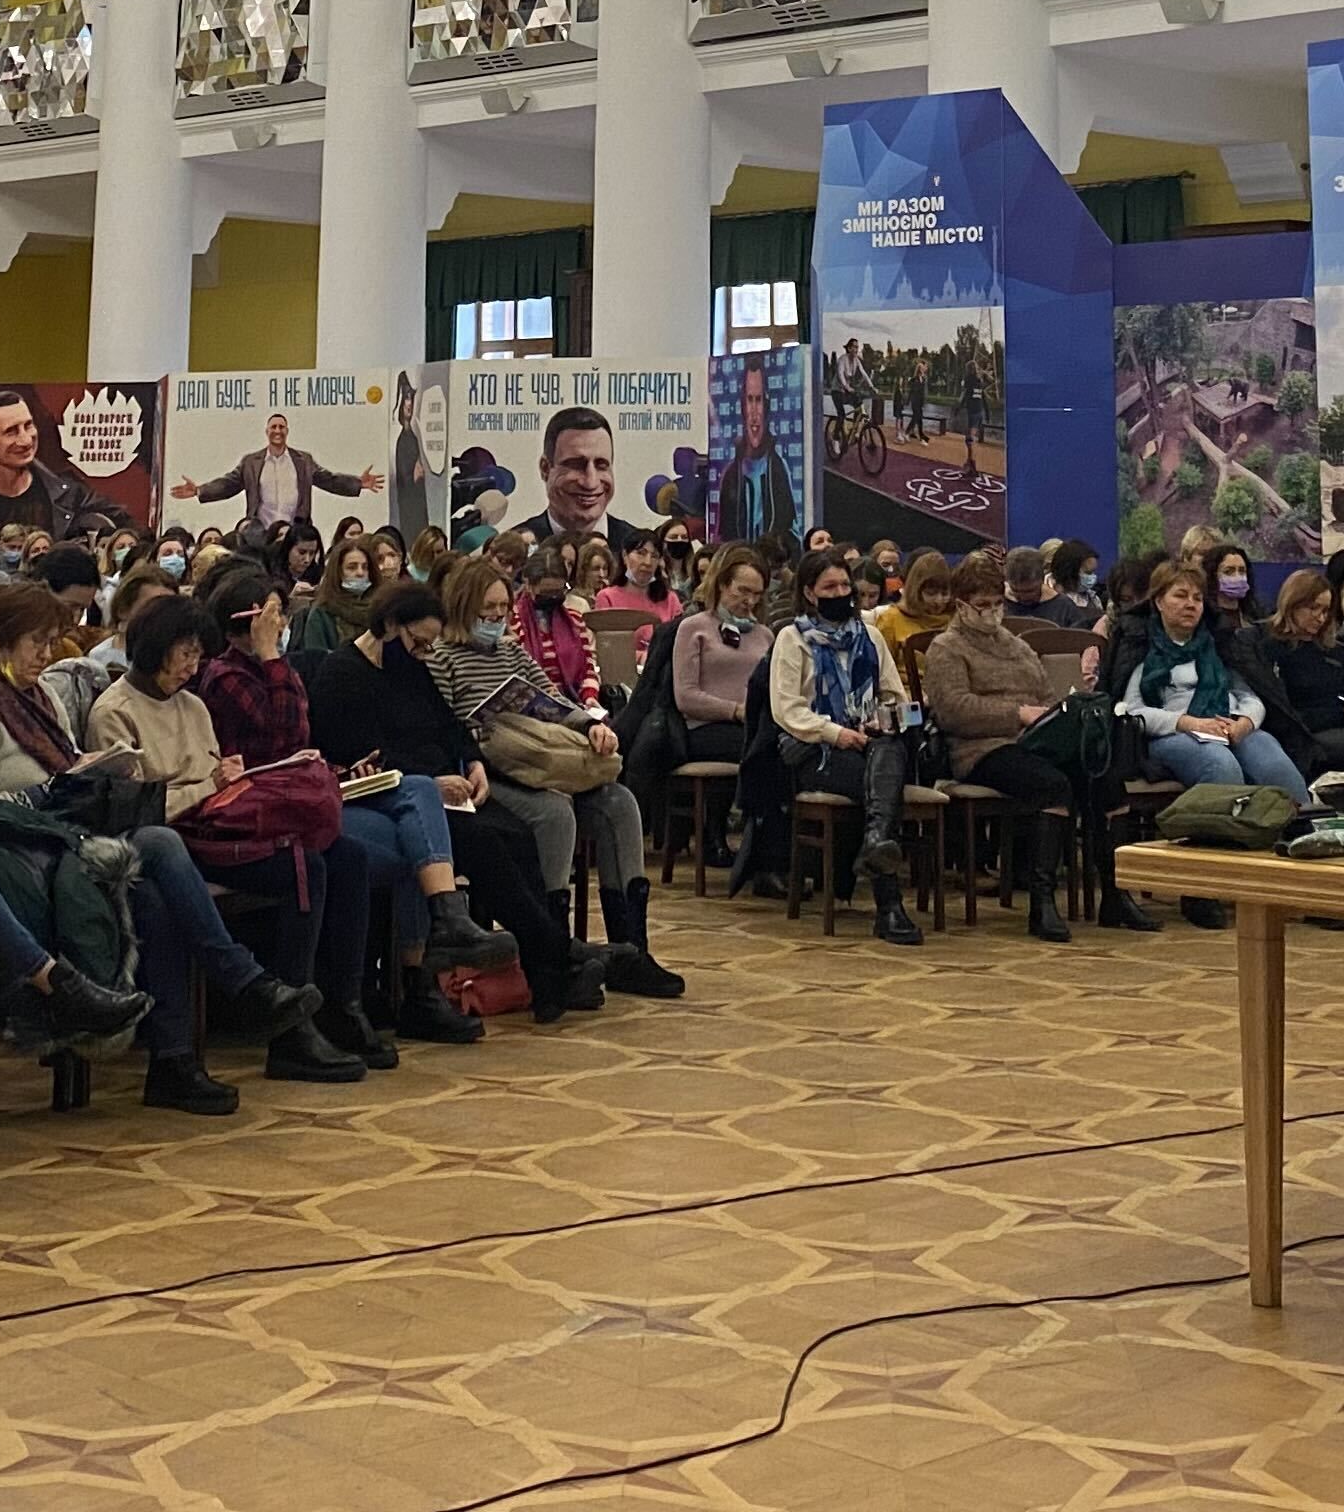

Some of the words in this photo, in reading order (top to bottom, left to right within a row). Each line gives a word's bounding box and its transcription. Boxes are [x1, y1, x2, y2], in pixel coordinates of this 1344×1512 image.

[858, 200, 883, 217] МИ
[888, 196, 944, 214] РАЗОМ
[842, 213, 937, 234] ЗМІНЮЄМО
[872, 231, 920, 248] НАШЕ
[926, 226, 984, 245] МІСТО!
[176, 380, 209, 411] ДАЛІ
[284, 378, 301, 407] НЕ
[468, 373, 497, 406] ХТО
[505, 373, 523, 406] НЕ
[572, 367, 600, 406] ТОЙ
[608, 372, 691, 405] ПОБАЧИТЬ!
[656, 412, 691, 431] КЛИЧКО
